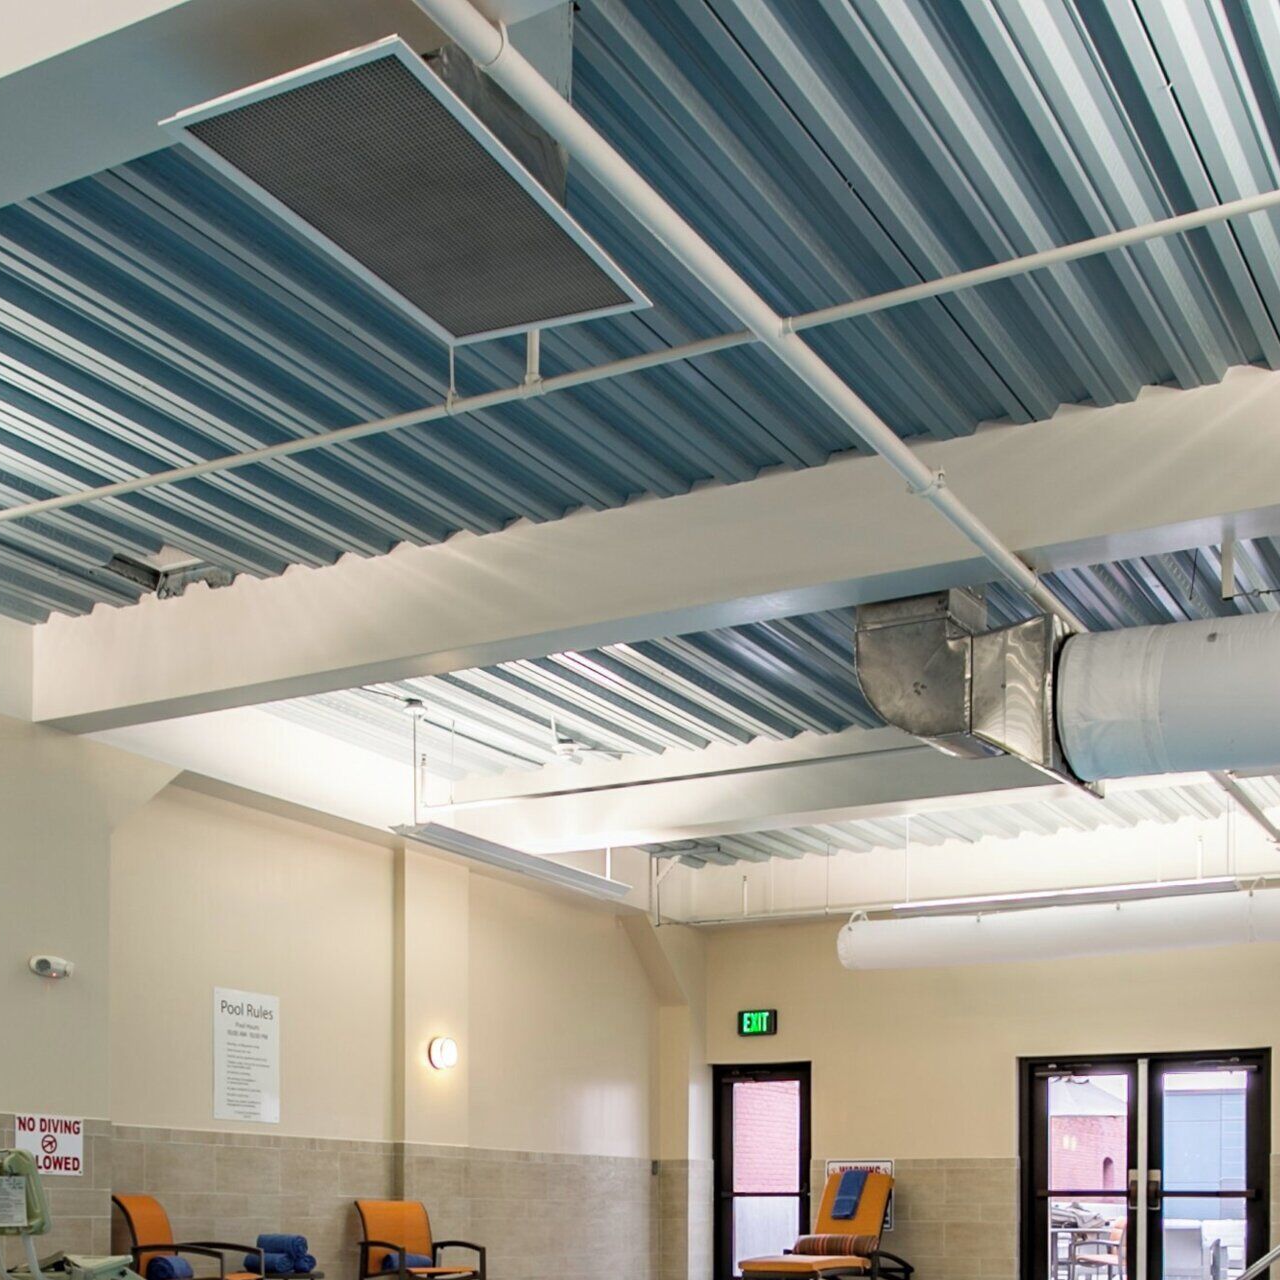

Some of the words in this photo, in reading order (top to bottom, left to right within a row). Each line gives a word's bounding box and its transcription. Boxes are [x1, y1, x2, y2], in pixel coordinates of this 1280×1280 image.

[220, 999, 244, 1016] Pool
[246, 1003, 274, 1021] Rules
[743, 1011, 770, 1033] EXIT
[18, 1116, 36, 1132] NO
[39, 1117, 81, 1135] DIVING
[35, 1154, 81, 1171] LOWED
